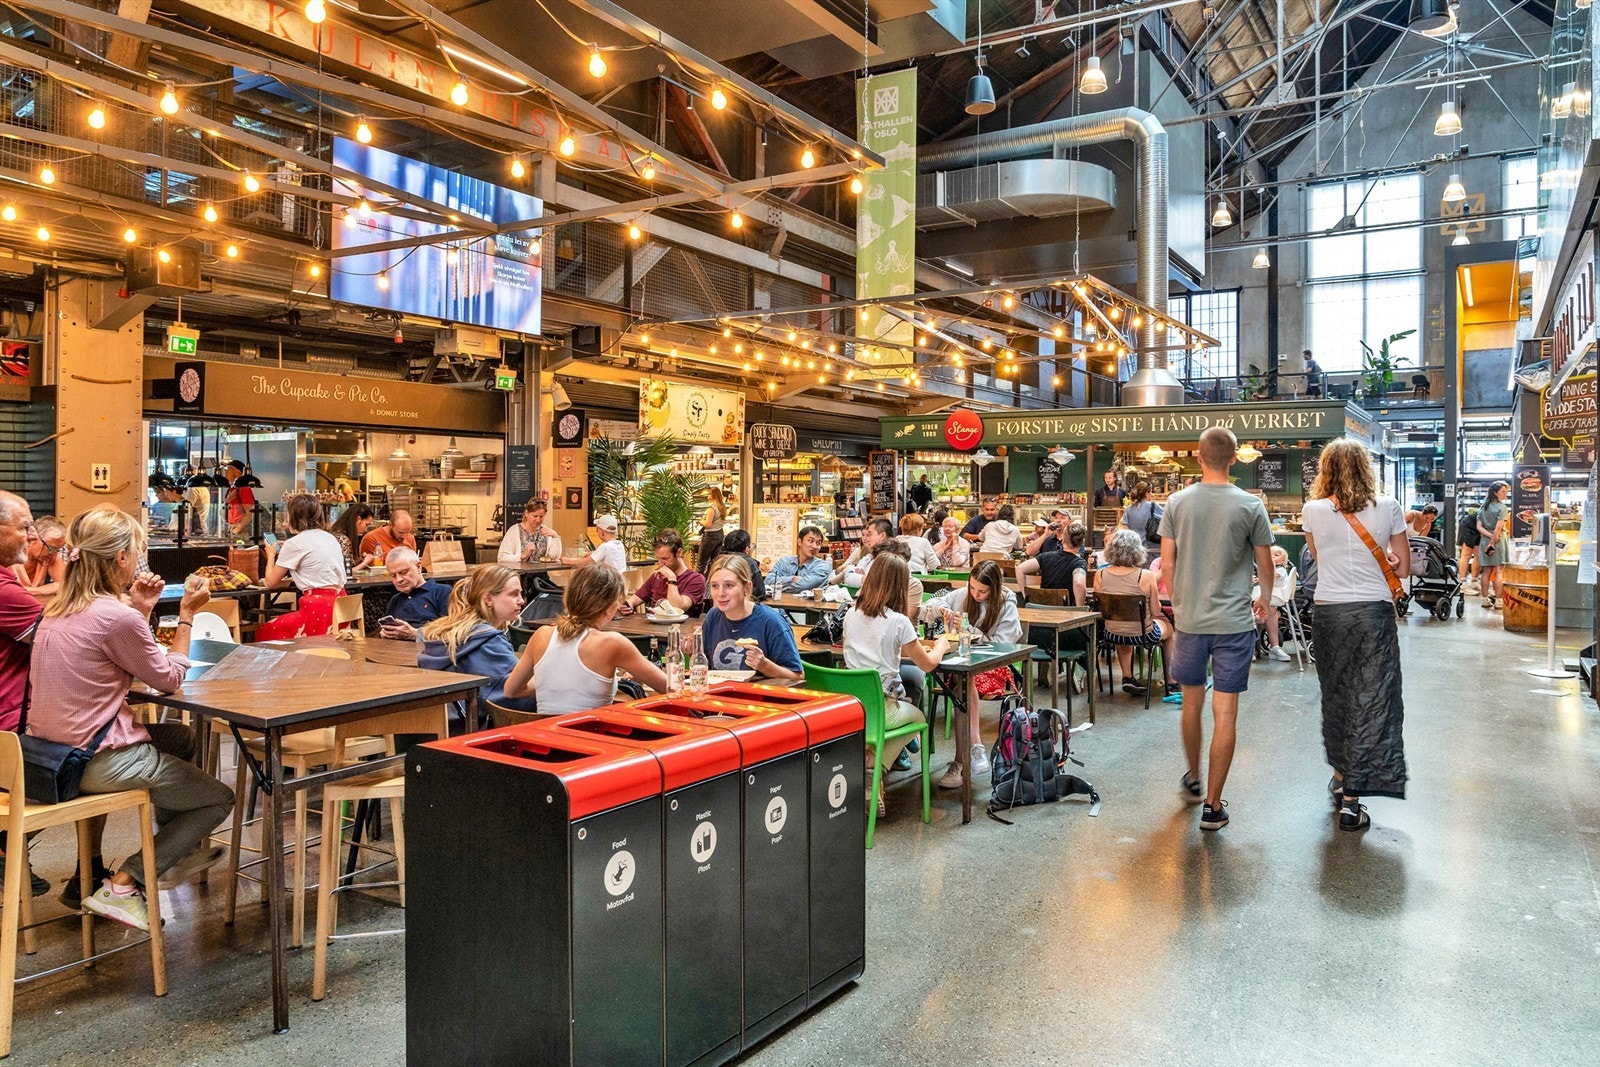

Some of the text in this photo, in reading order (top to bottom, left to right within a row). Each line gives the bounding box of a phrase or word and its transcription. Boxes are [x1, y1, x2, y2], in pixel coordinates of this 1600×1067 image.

[265, 3, 574, 145] KULINRISK
[860, 115, 913, 131] MATHALLEN
[874, 128, 898, 138] OSLO
[251, 375, 389, 404] The Cupcake & Pie Co.
[1546, 382, 1587, 399] CANING
[376, 409, 398, 417] DONUT
[400, 411, 419, 419] STORE
[997, 419, 1064, 435] FØRSTE
[1069, 421, 1086, 436] og
[1091, 417, 1143, 433] SISTE
[1151, 413, 1209, 432] HÅND
[1215, 414, 1234, 430] på
[1239, 411, 1326, 429] VERKET
[683, 429, 710, 440] Simply Tasty
[754, 426, 792, 441] DUCK SANDWICH
[948, 421, 979, 441] Stange
[754, 439, 791, 450] WINE & CHEESE
[770, 784, 782, 794] Paper
[696, 810, 711, 821] Plastic
[612, 838, 627, 849] Food
[771, 834, 783, 844] Papir
[698, 863, 711, 874] Plast
[606, 892, 634, 910] Matavfall
